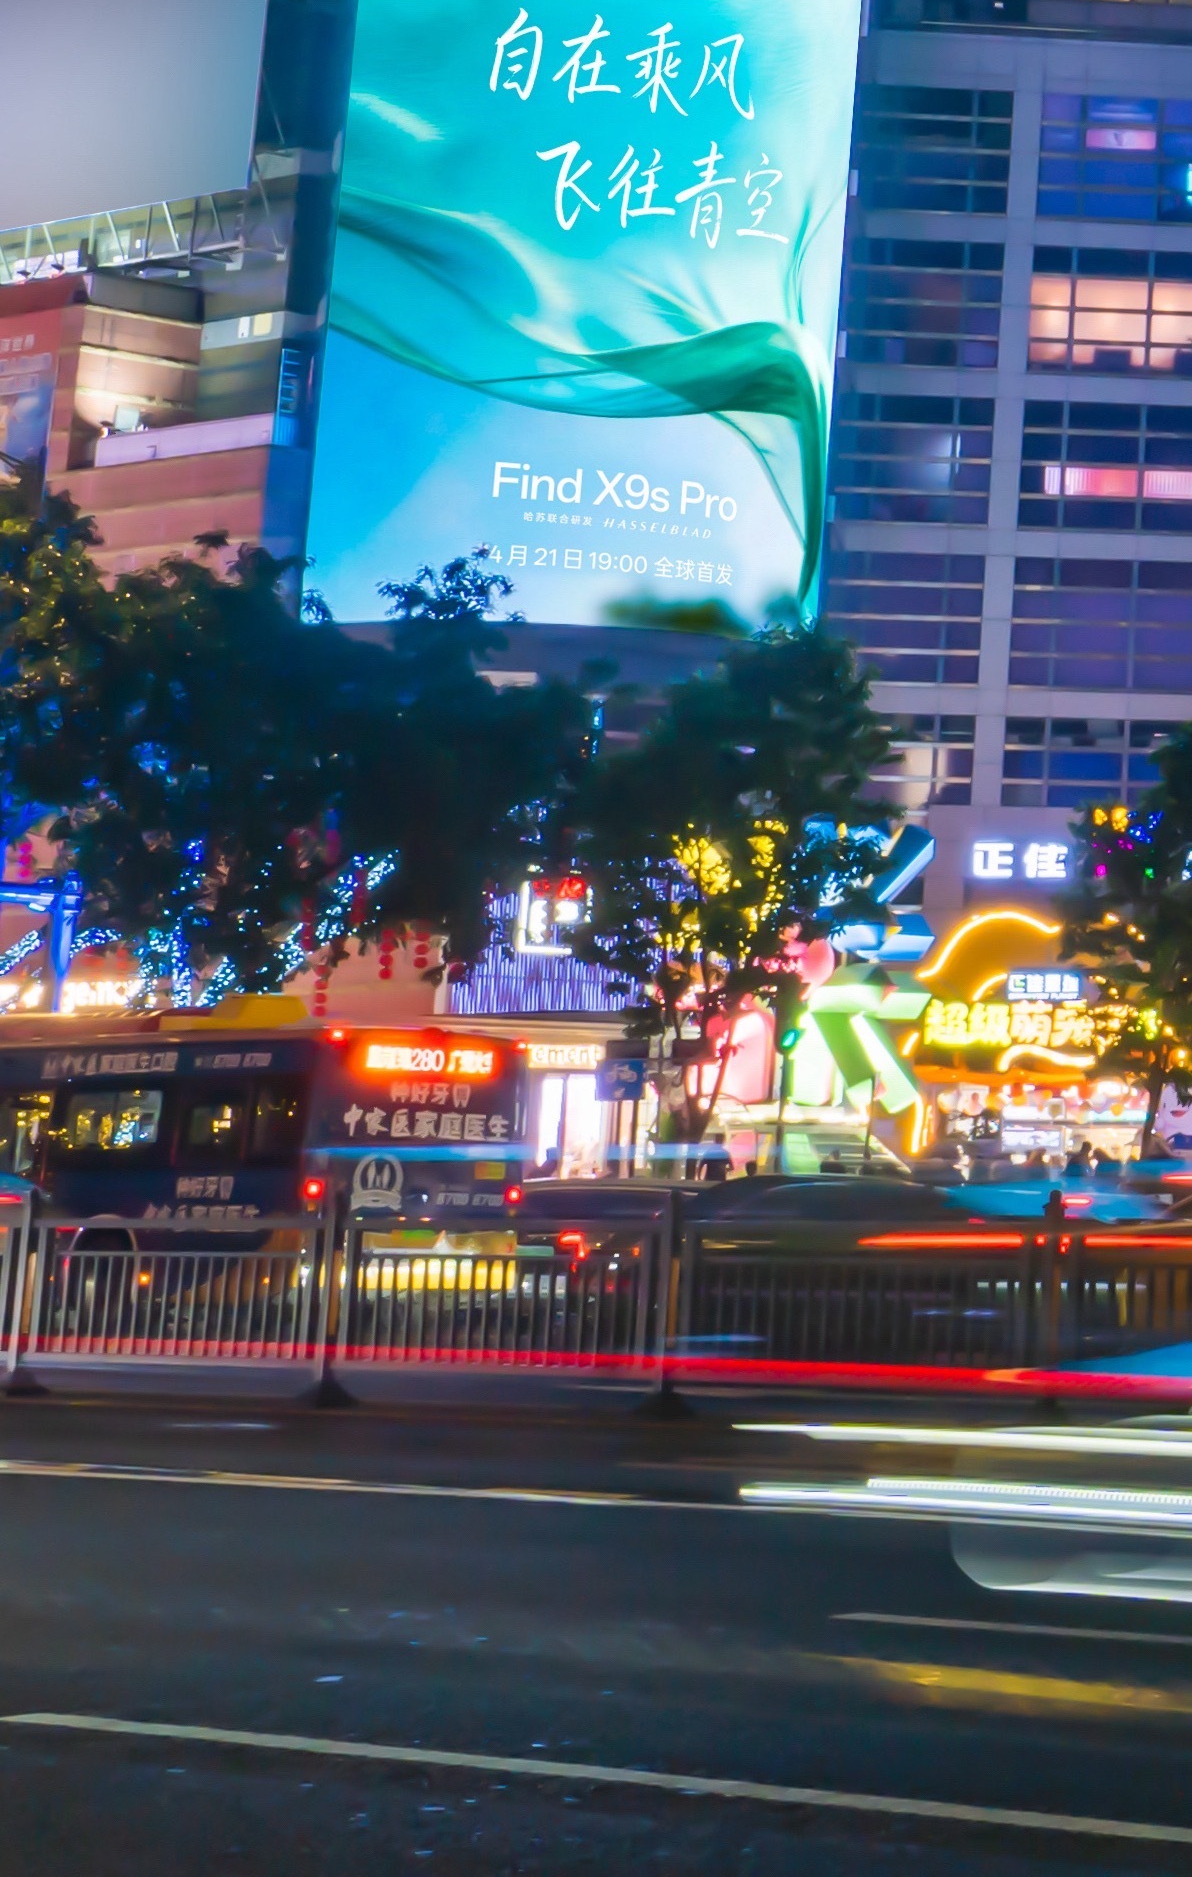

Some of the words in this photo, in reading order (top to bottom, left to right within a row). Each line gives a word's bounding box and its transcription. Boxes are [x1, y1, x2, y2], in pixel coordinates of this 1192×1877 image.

[489, 8, 755, 120] 自在乘风
[536, 141, 789, 249] 飞往青空
[492, 461, 583, 504] Find
[593, 469, 670, 513] X9s
[680, 480, 738, 521] Pro
[523, 511, 593, 526] 哈苏联合研发
[603, 517, 712, 539] HASSELBLAD
[654, 556, 734, 586] 全球首发
